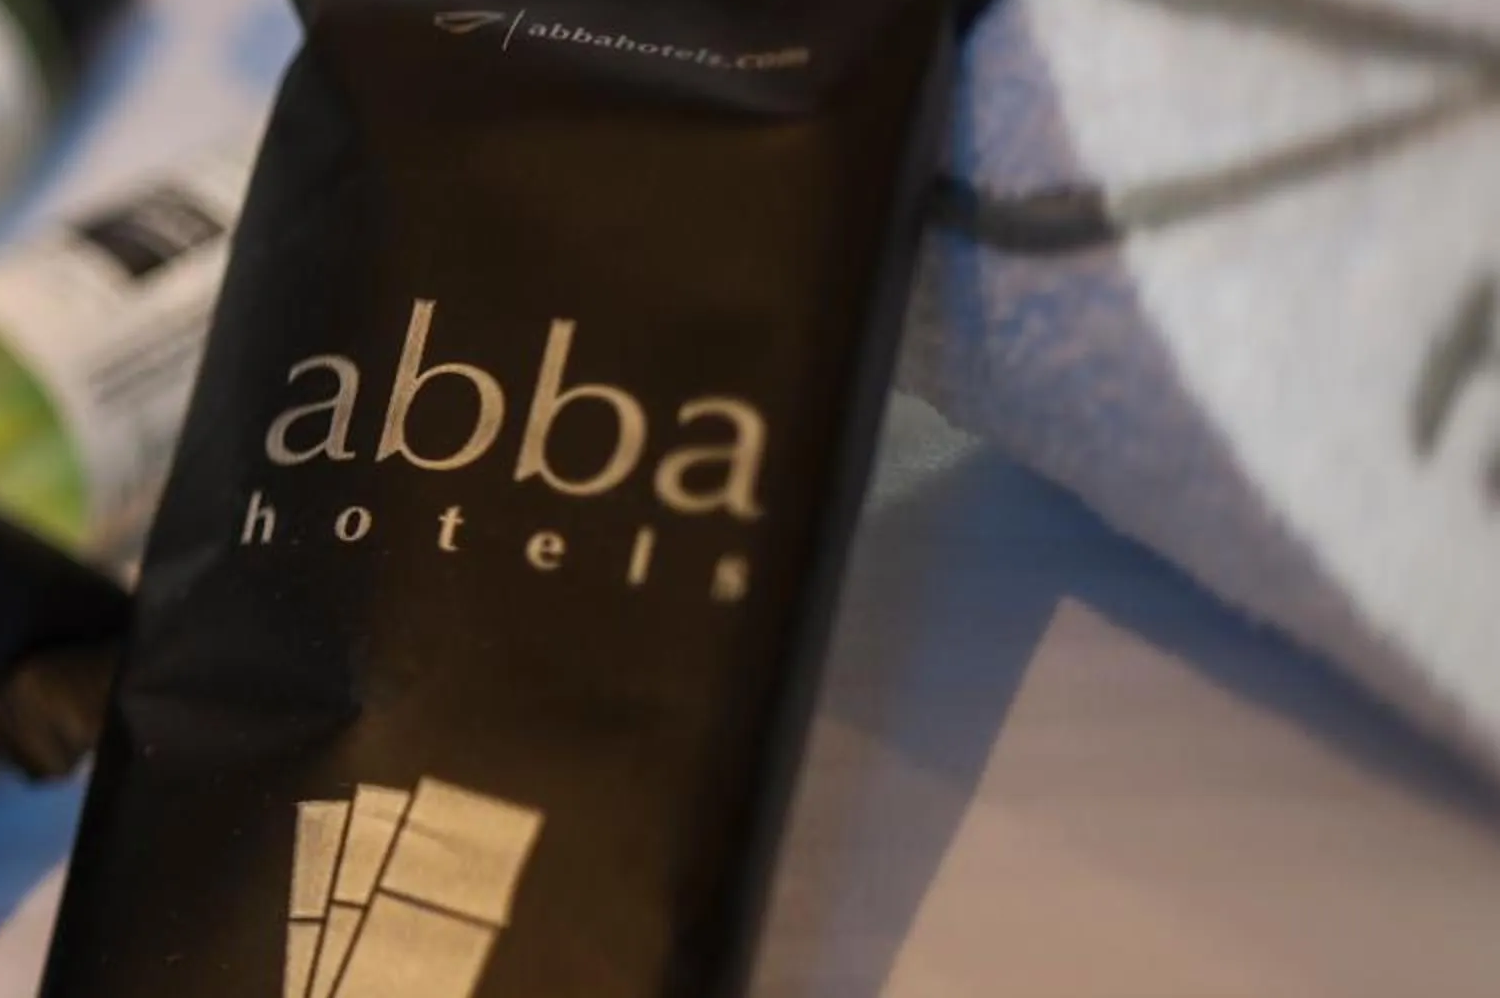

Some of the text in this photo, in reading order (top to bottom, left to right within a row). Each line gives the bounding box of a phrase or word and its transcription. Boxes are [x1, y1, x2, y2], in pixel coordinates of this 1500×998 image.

[527, 21, 811, 71] abbahotels.com
[264, 298, 768, 521] abba
[240, 490, 750, 602] hotels
